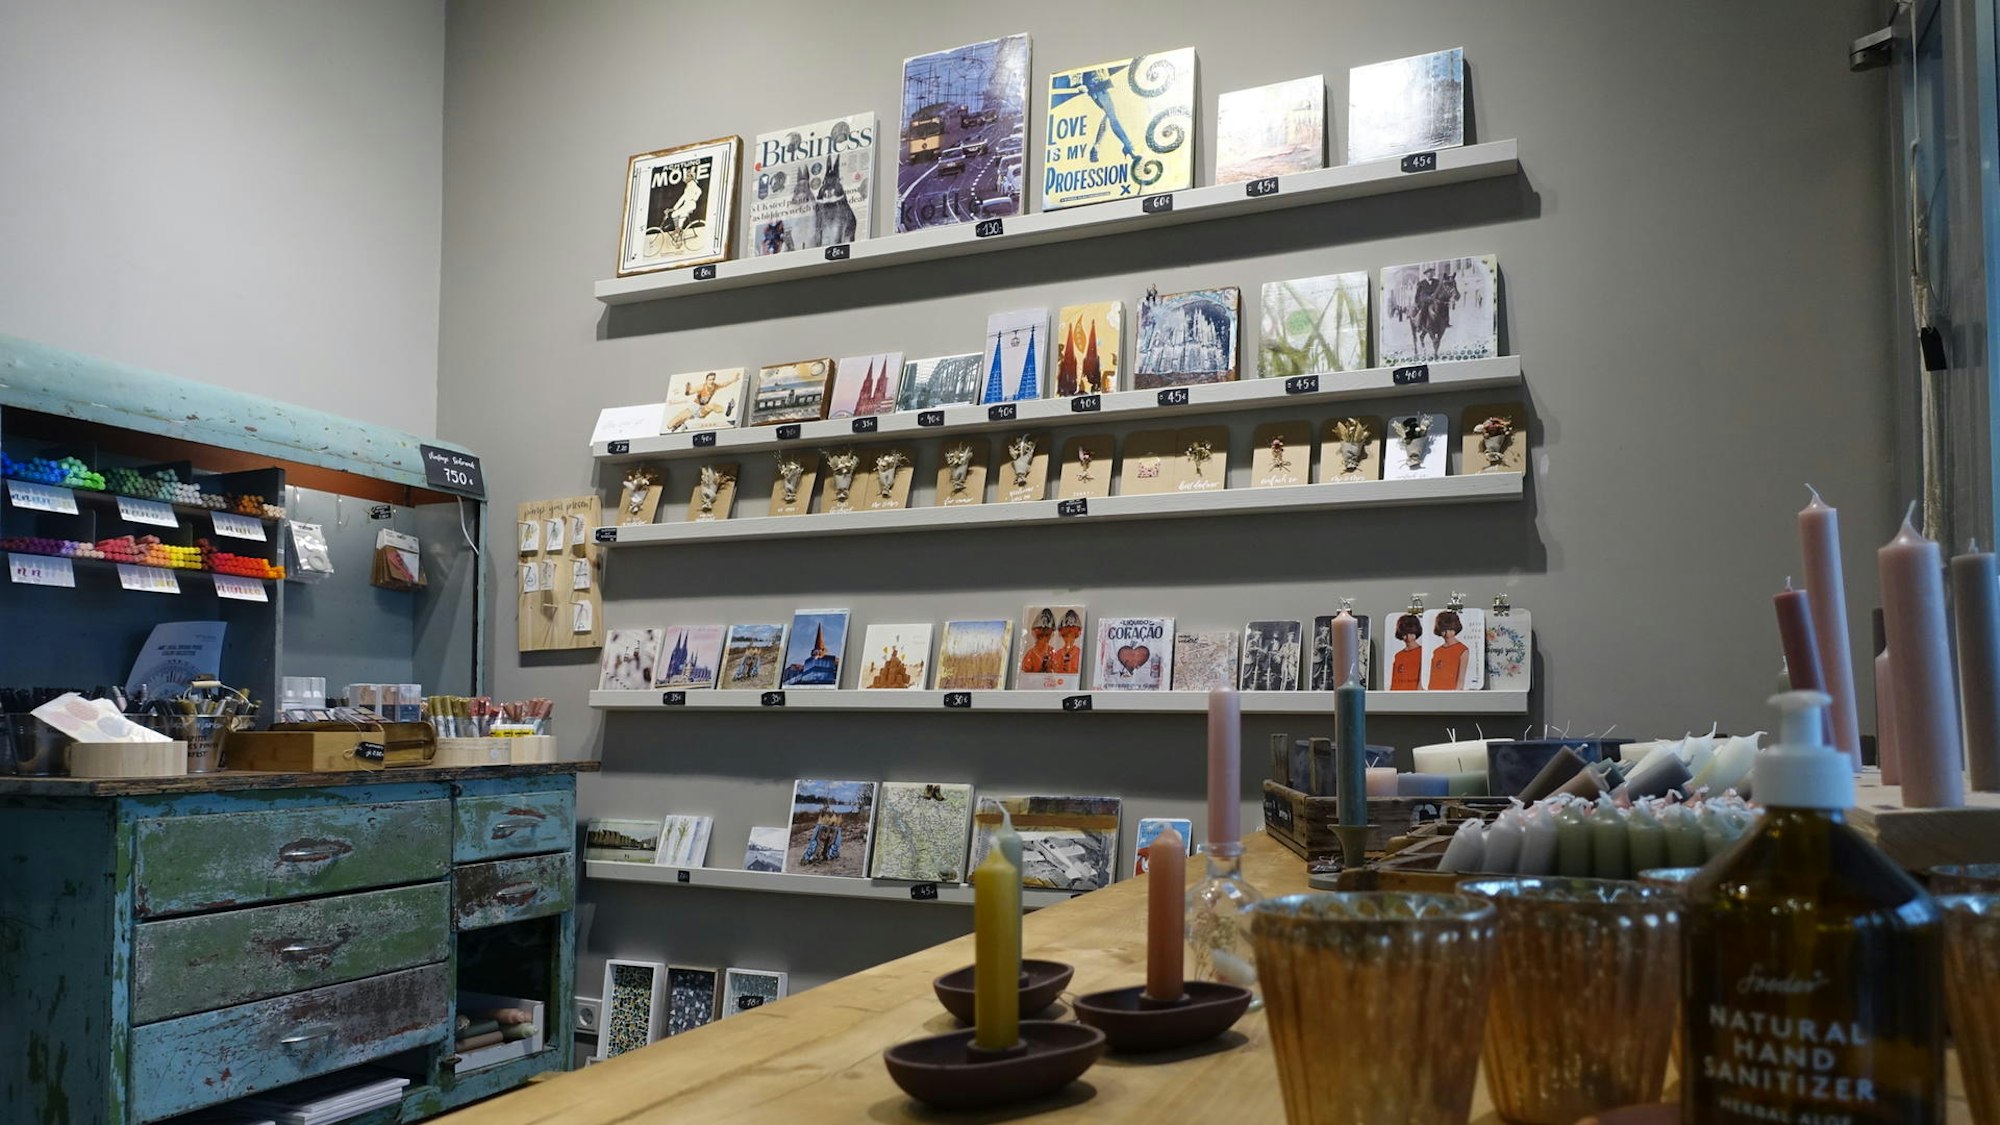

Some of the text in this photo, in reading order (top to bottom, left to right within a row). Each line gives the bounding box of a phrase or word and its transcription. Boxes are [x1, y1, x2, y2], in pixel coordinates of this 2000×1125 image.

[1048, 114, 1087, 145] LOVE
[762, 127, 872, 168] Business
[1047, 144, 1087, 162] IS MY
[1045, 163, 1128, 195] PROFESSION
[1709, 1004, 1868, 1046] NATURAL
[1733, 1036, 1836, 1071] HAND
[1704, 1055, 1876, 1103] SANITIZER
